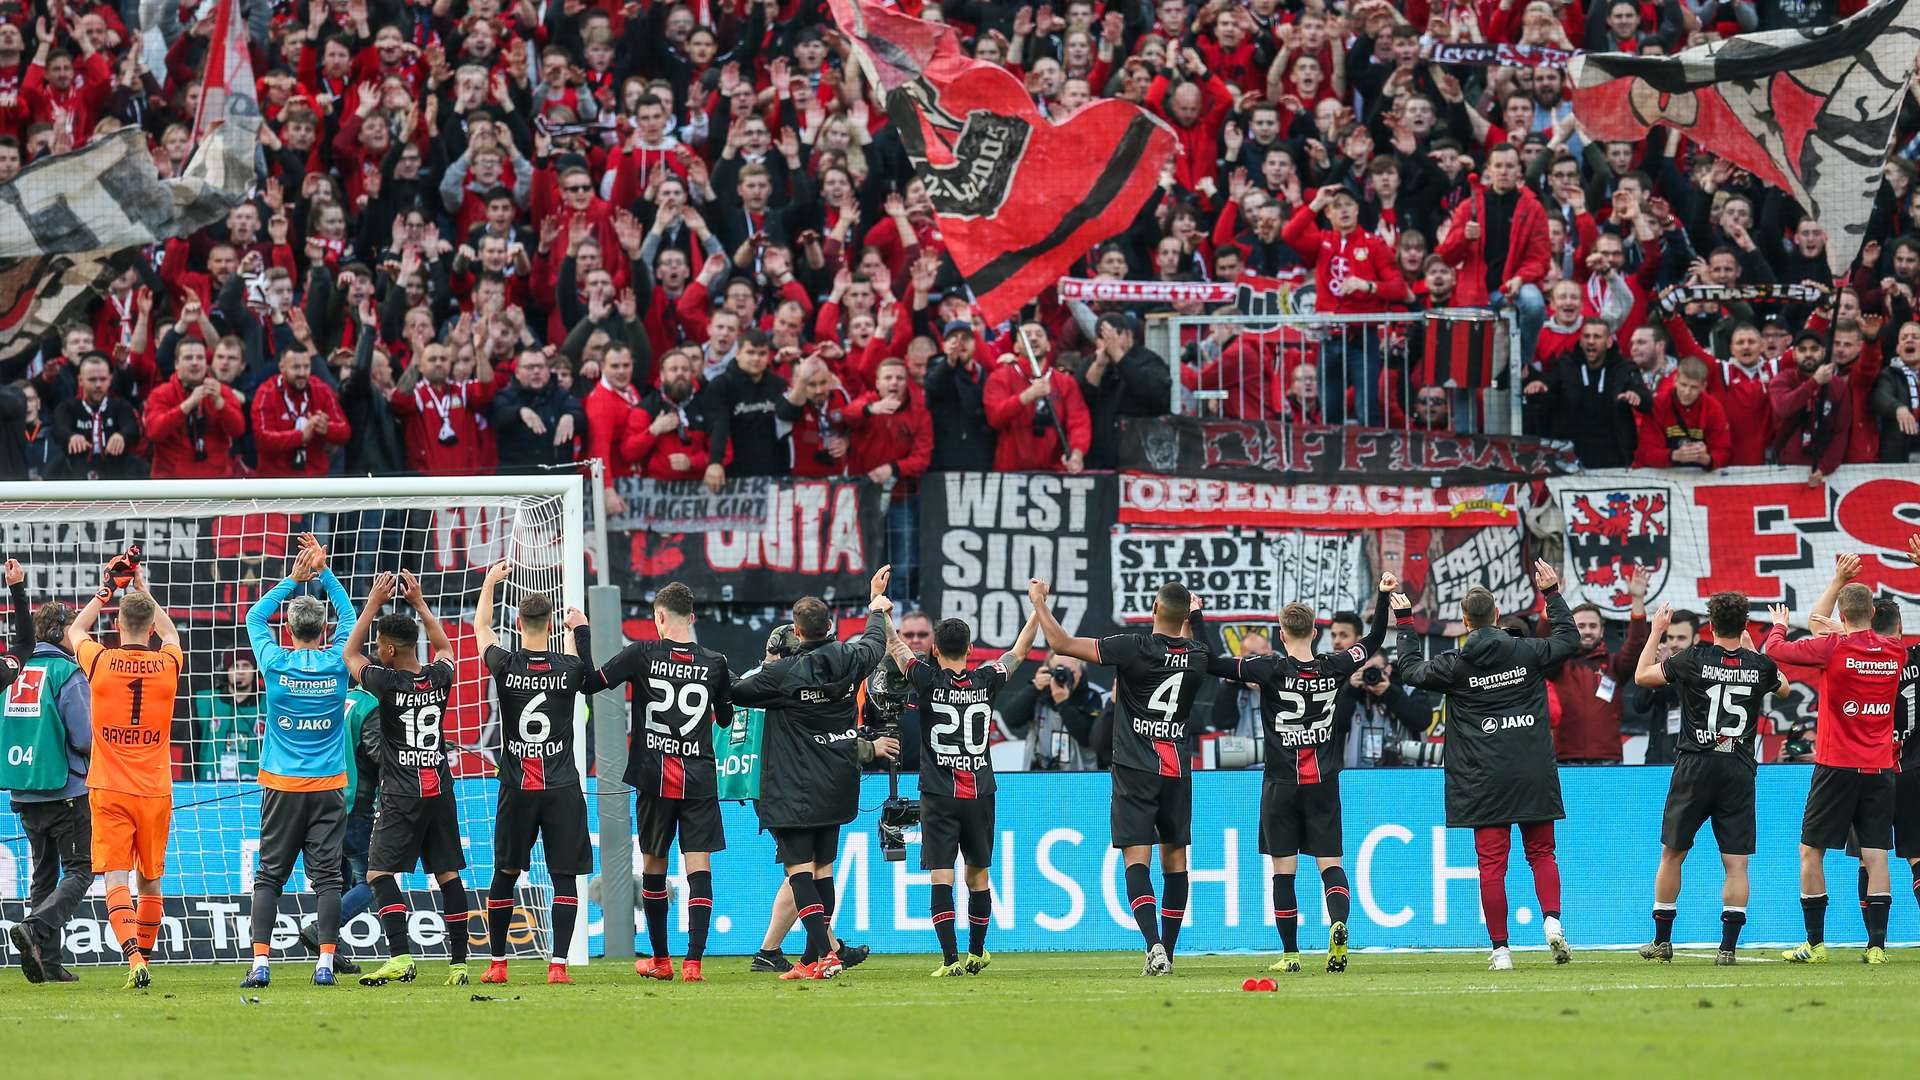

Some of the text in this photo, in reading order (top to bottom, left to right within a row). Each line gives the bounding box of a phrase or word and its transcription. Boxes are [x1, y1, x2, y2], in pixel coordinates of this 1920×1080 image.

[944, 471, 1095, 532] WEST
[1130, 477, 1434, 514] OFFENBACH
[941, 529, 1089, 594] SIDE
[1120, 538, 1272, 569] STADT
[1488, 545, 1522, 592] DIE
[1121, 570, 1272, 593] VERBOTE
[1121, 593, 1271, 613] AUEBEN
[109, 657, 166, 674] HRADECKY
[651, 659, 709, 681] HAVERTZ
[1164, 653, 1189, 668] TAH
[1845, 657, 1899, 670] Barmenia
[279, 674, 338, 689] Barmenia
[505, 671, 568, 690] DRAGOVIĆ
[1469, 665, 1528, 689] Barmenia
[1701, 664, 1760, 684] BAUMGARTLINGER
[1857, 668, 1897, 676] Versicherungen
[1284, 676, 1336, 692] WEISER
[1483, 676, 1525, 691] Versicherungen
[127, 677, 144, 726] 1
[395, 687, 447, 707] WENDELL
[932, 688, 947, 703] CH.
[1147, 671, 1185, 722] 4
[518, 691, 551, 743] 6
[645, 677, 709, 737] 29
[1275, 687, 1339, 733] 23
[1705, 683, 1753, 737] 15
[1861, 703, 1891, 715] JAKO
[296, 718, 332, 730] JAKO
[399, 704, 442, 751] 18
[930, 702, 992, 755] 20
[1133, 717, 1169, 738] BAYER
[1501, 714, 1535, 730] JAKO
[102, 727, 161, 745] BAYER 04
[646, 732, 700, 757] BAYER 04
[1282, 729, 1316, 747] BAYER
[7, 745, 34, 766] 04
[399, 750, 436, 767] BAYER
[508, 739, 564, 759] BAYER 04
